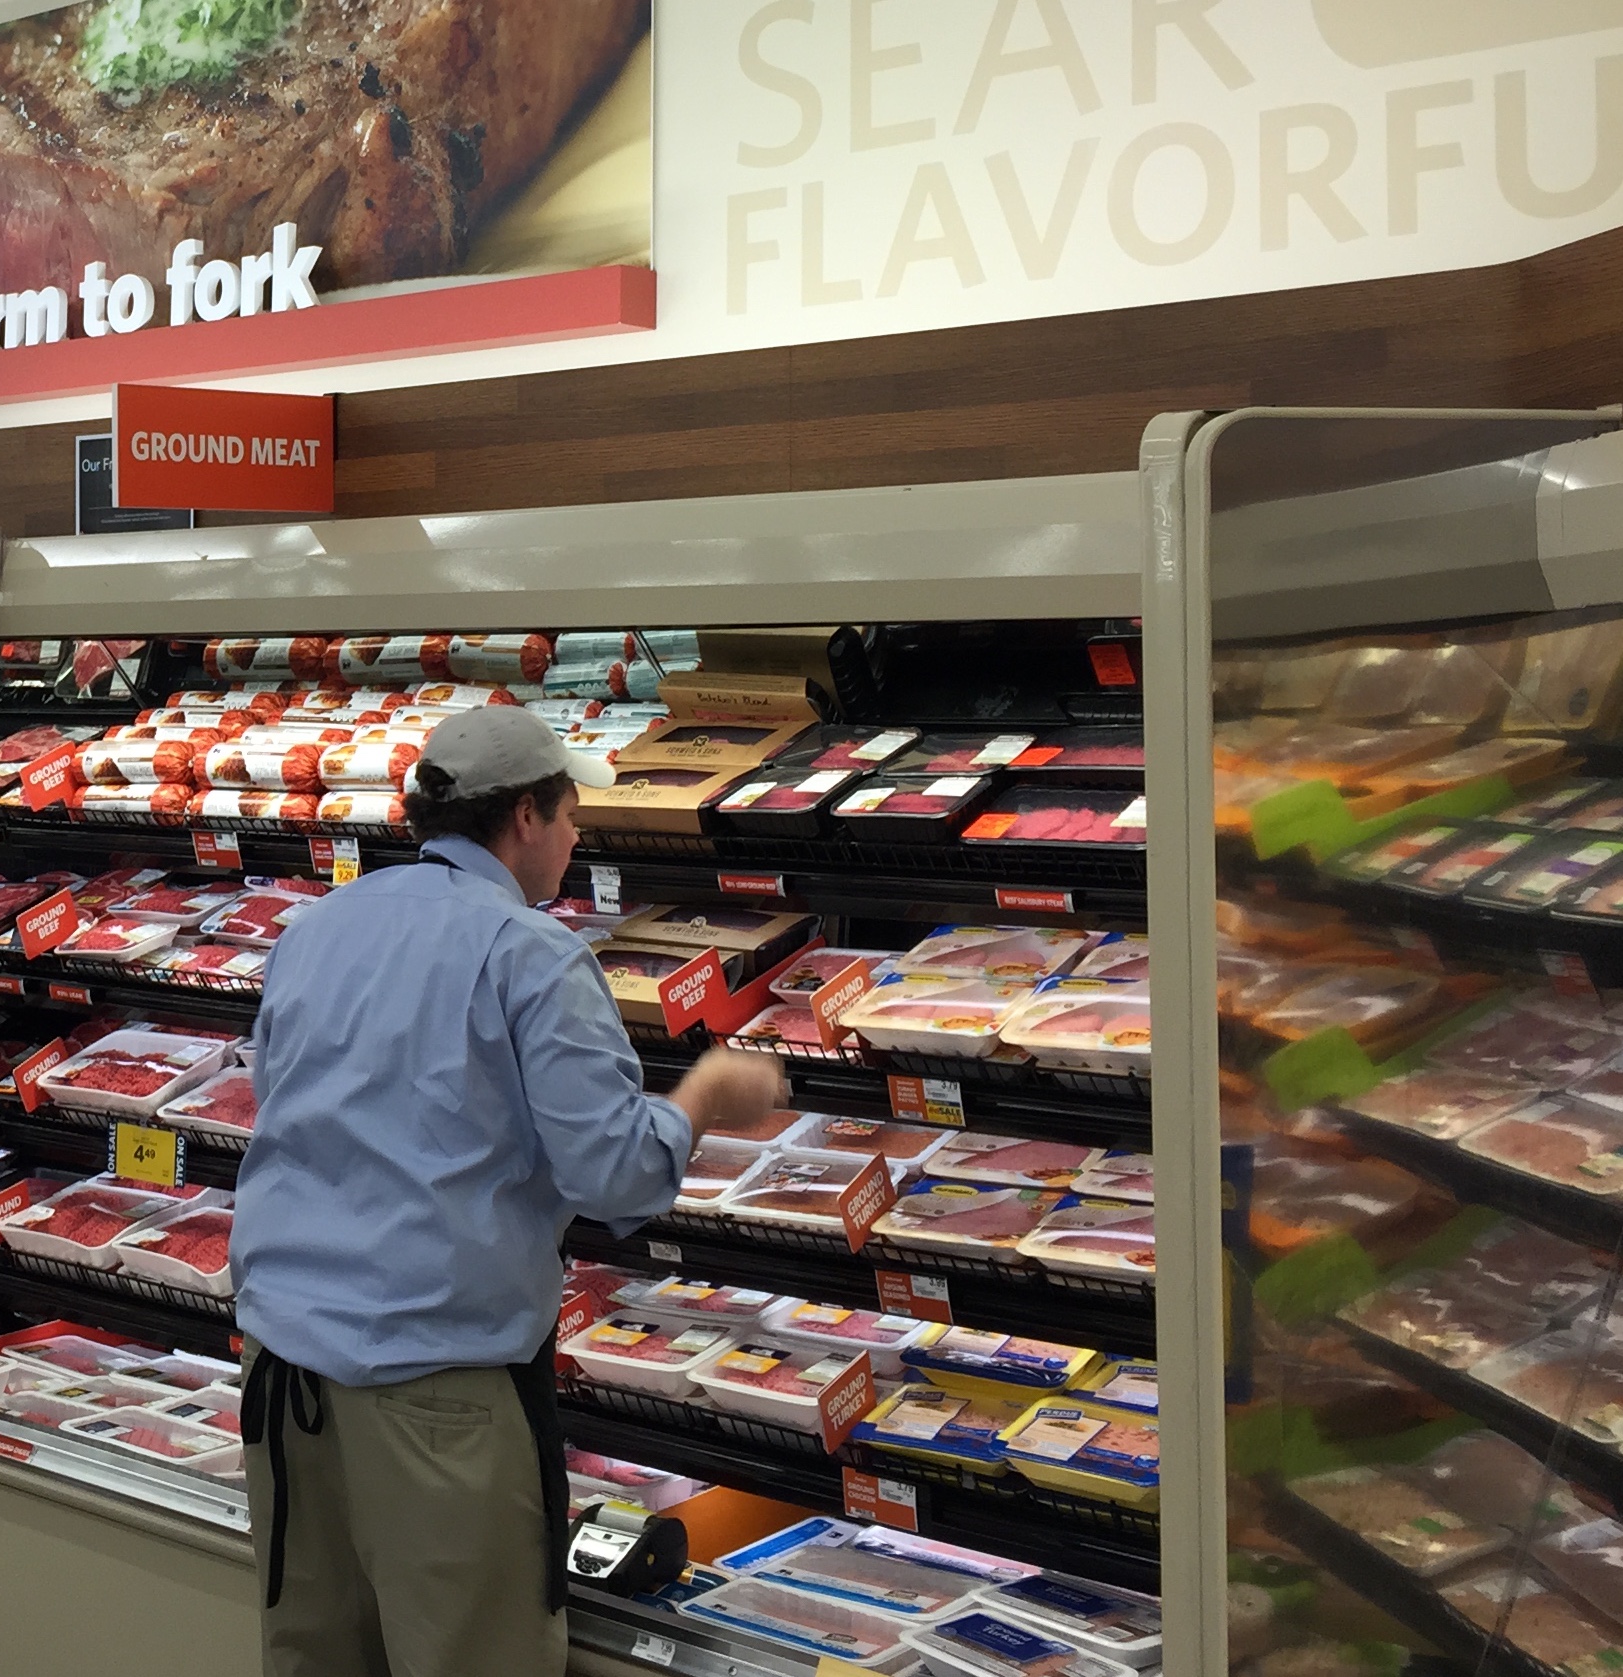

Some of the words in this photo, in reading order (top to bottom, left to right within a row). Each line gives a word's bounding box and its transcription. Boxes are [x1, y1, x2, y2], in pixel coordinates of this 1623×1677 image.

[79, 261, 155, 338] to
[167, 222, 323, 327] fork
[131, 431, 244, 464] GROUND
[250, 437, 321, 467] MEAT
[81, 458, 101, 473] Our
[28, 754, 71, 785] GROUND
[41, 769, 66, 792] BEEF
[337, 870, 354, 881] 9.29
[600, 894, 621, 905] New
[26, 902, 66, 934] GROUND
[38, 918, 61, 940] BEEF
[668, 964, 714, 1003] GROUND
[682, 984, 707, 1011] BEEF
[821, 975, 864, 1017] GROUND
[22, 1050, 61, 1086] GROUND
[108, 1122, 117, 1151] SALE
[176, 1136, 185, 1156] ON
[107, 1153, 116, 1172] ON
[175, 1157, 184, 1187] SALE
[847, 1170, 884, 1215] GROUND
[852, 1190, 887, 1231] TURKEY
[556, 1309, 585, 1337] OUND
[1119, 1365, 1158, 1374] PERDU
[827, 1372, 866, 1416] GROUND
[831, 1388, 869, 1431] TURKEY
